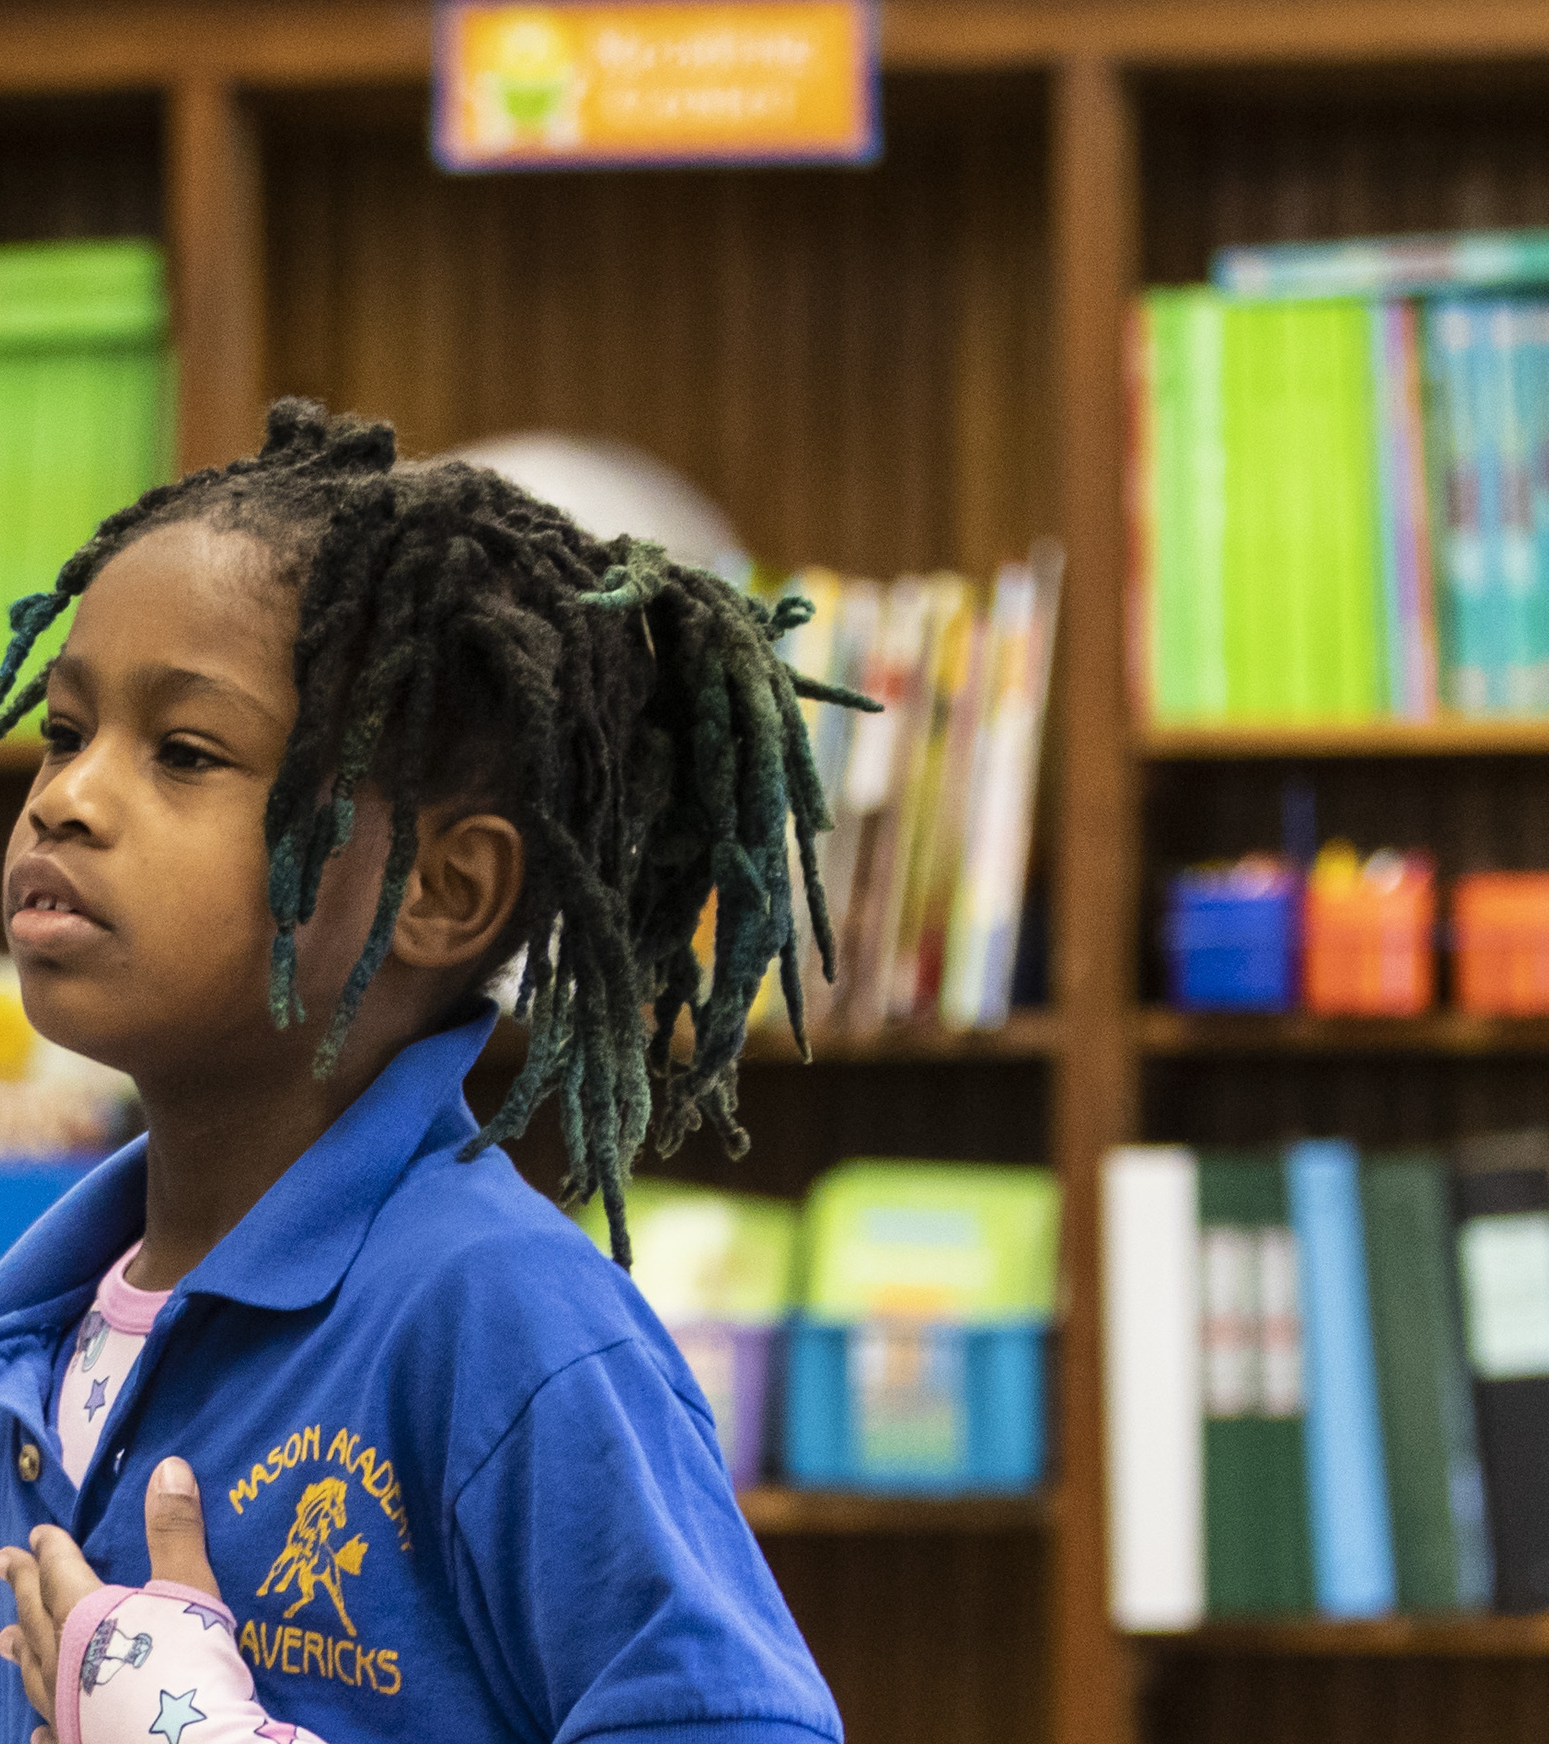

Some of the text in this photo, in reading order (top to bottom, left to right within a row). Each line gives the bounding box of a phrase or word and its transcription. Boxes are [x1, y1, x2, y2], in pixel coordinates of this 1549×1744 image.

[229, 1424, 413, 1551] MASON ACADE
[239, 1619, 402, 1695] AVERICKS
